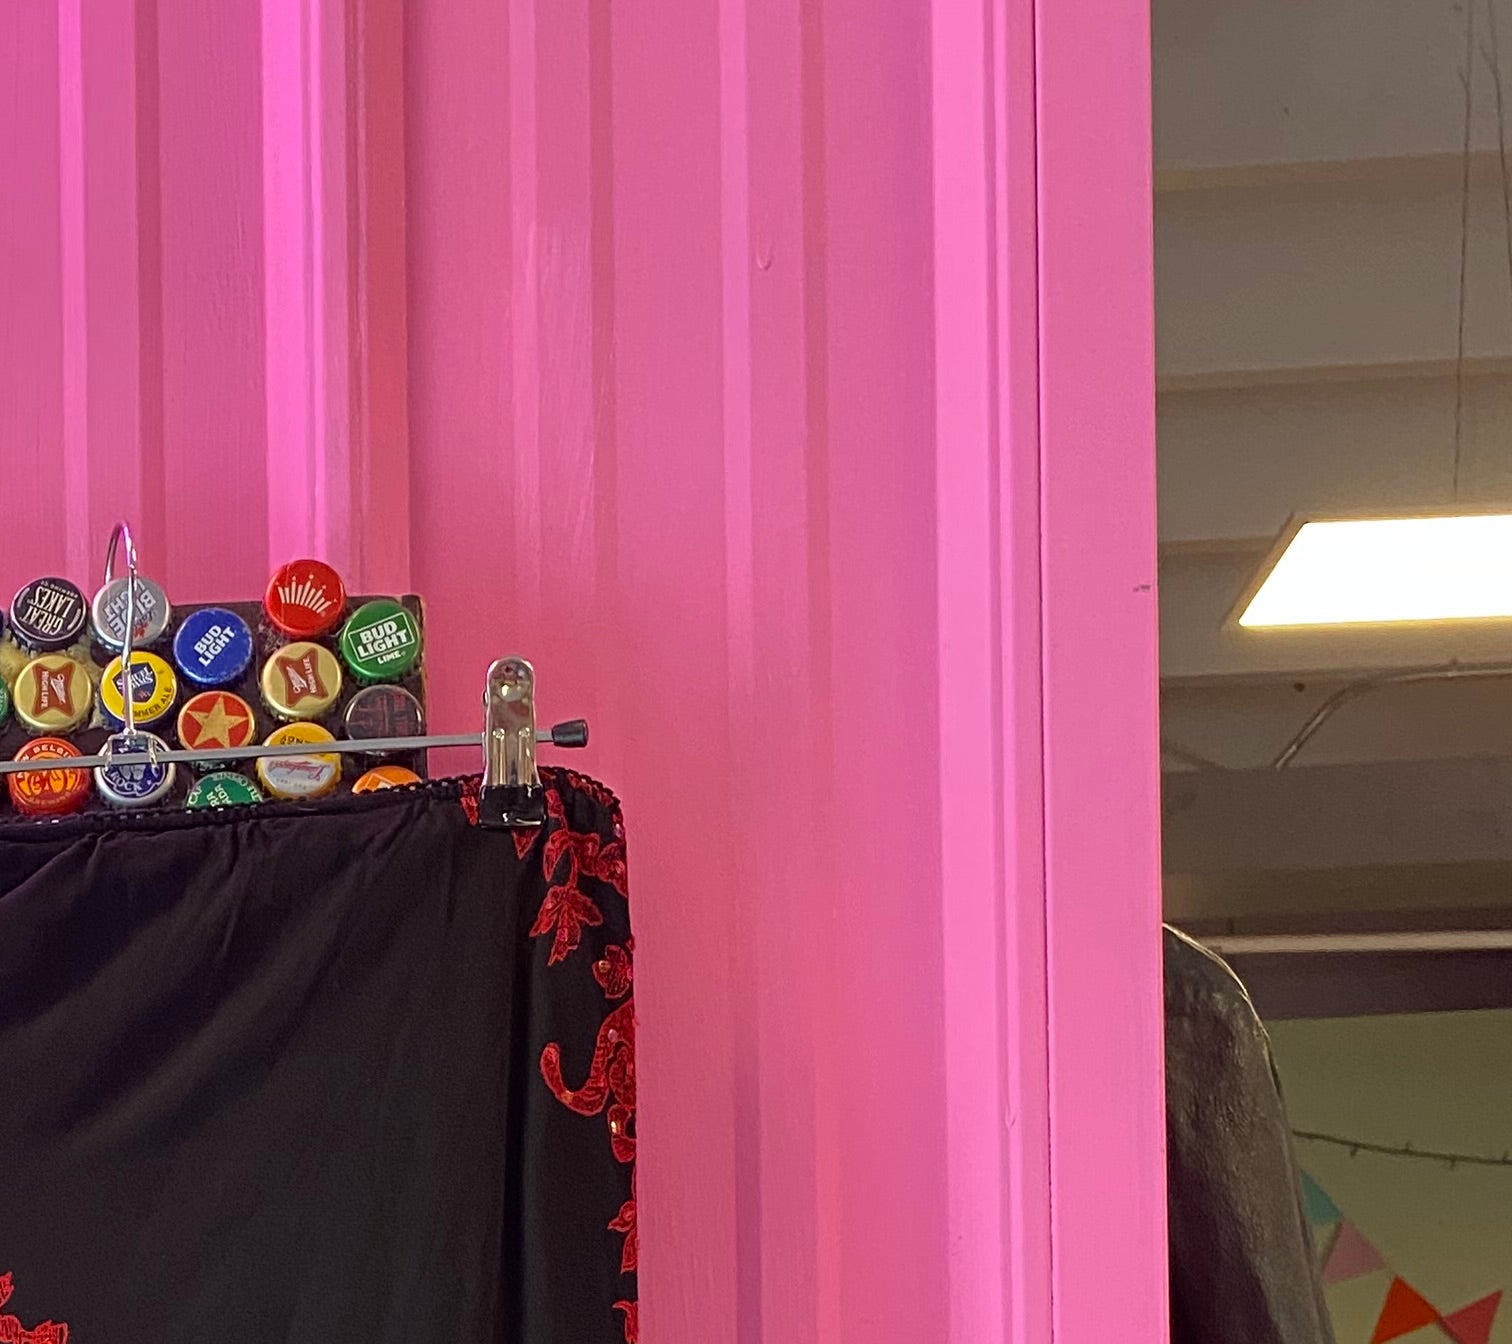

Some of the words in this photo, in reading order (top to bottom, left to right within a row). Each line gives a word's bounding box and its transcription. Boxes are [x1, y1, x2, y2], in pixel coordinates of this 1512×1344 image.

[36, 586, 75, 618] LAKES
[19, 605, 64, 636] GREAT
[358, 620, 398, 644] BUD
[194, 624, 221, 655] BUD
[198, 626, 236, 667] LIGHT
[356, 629, 409, 658] LIGHT
[377, 651, 401, 664] LIME
